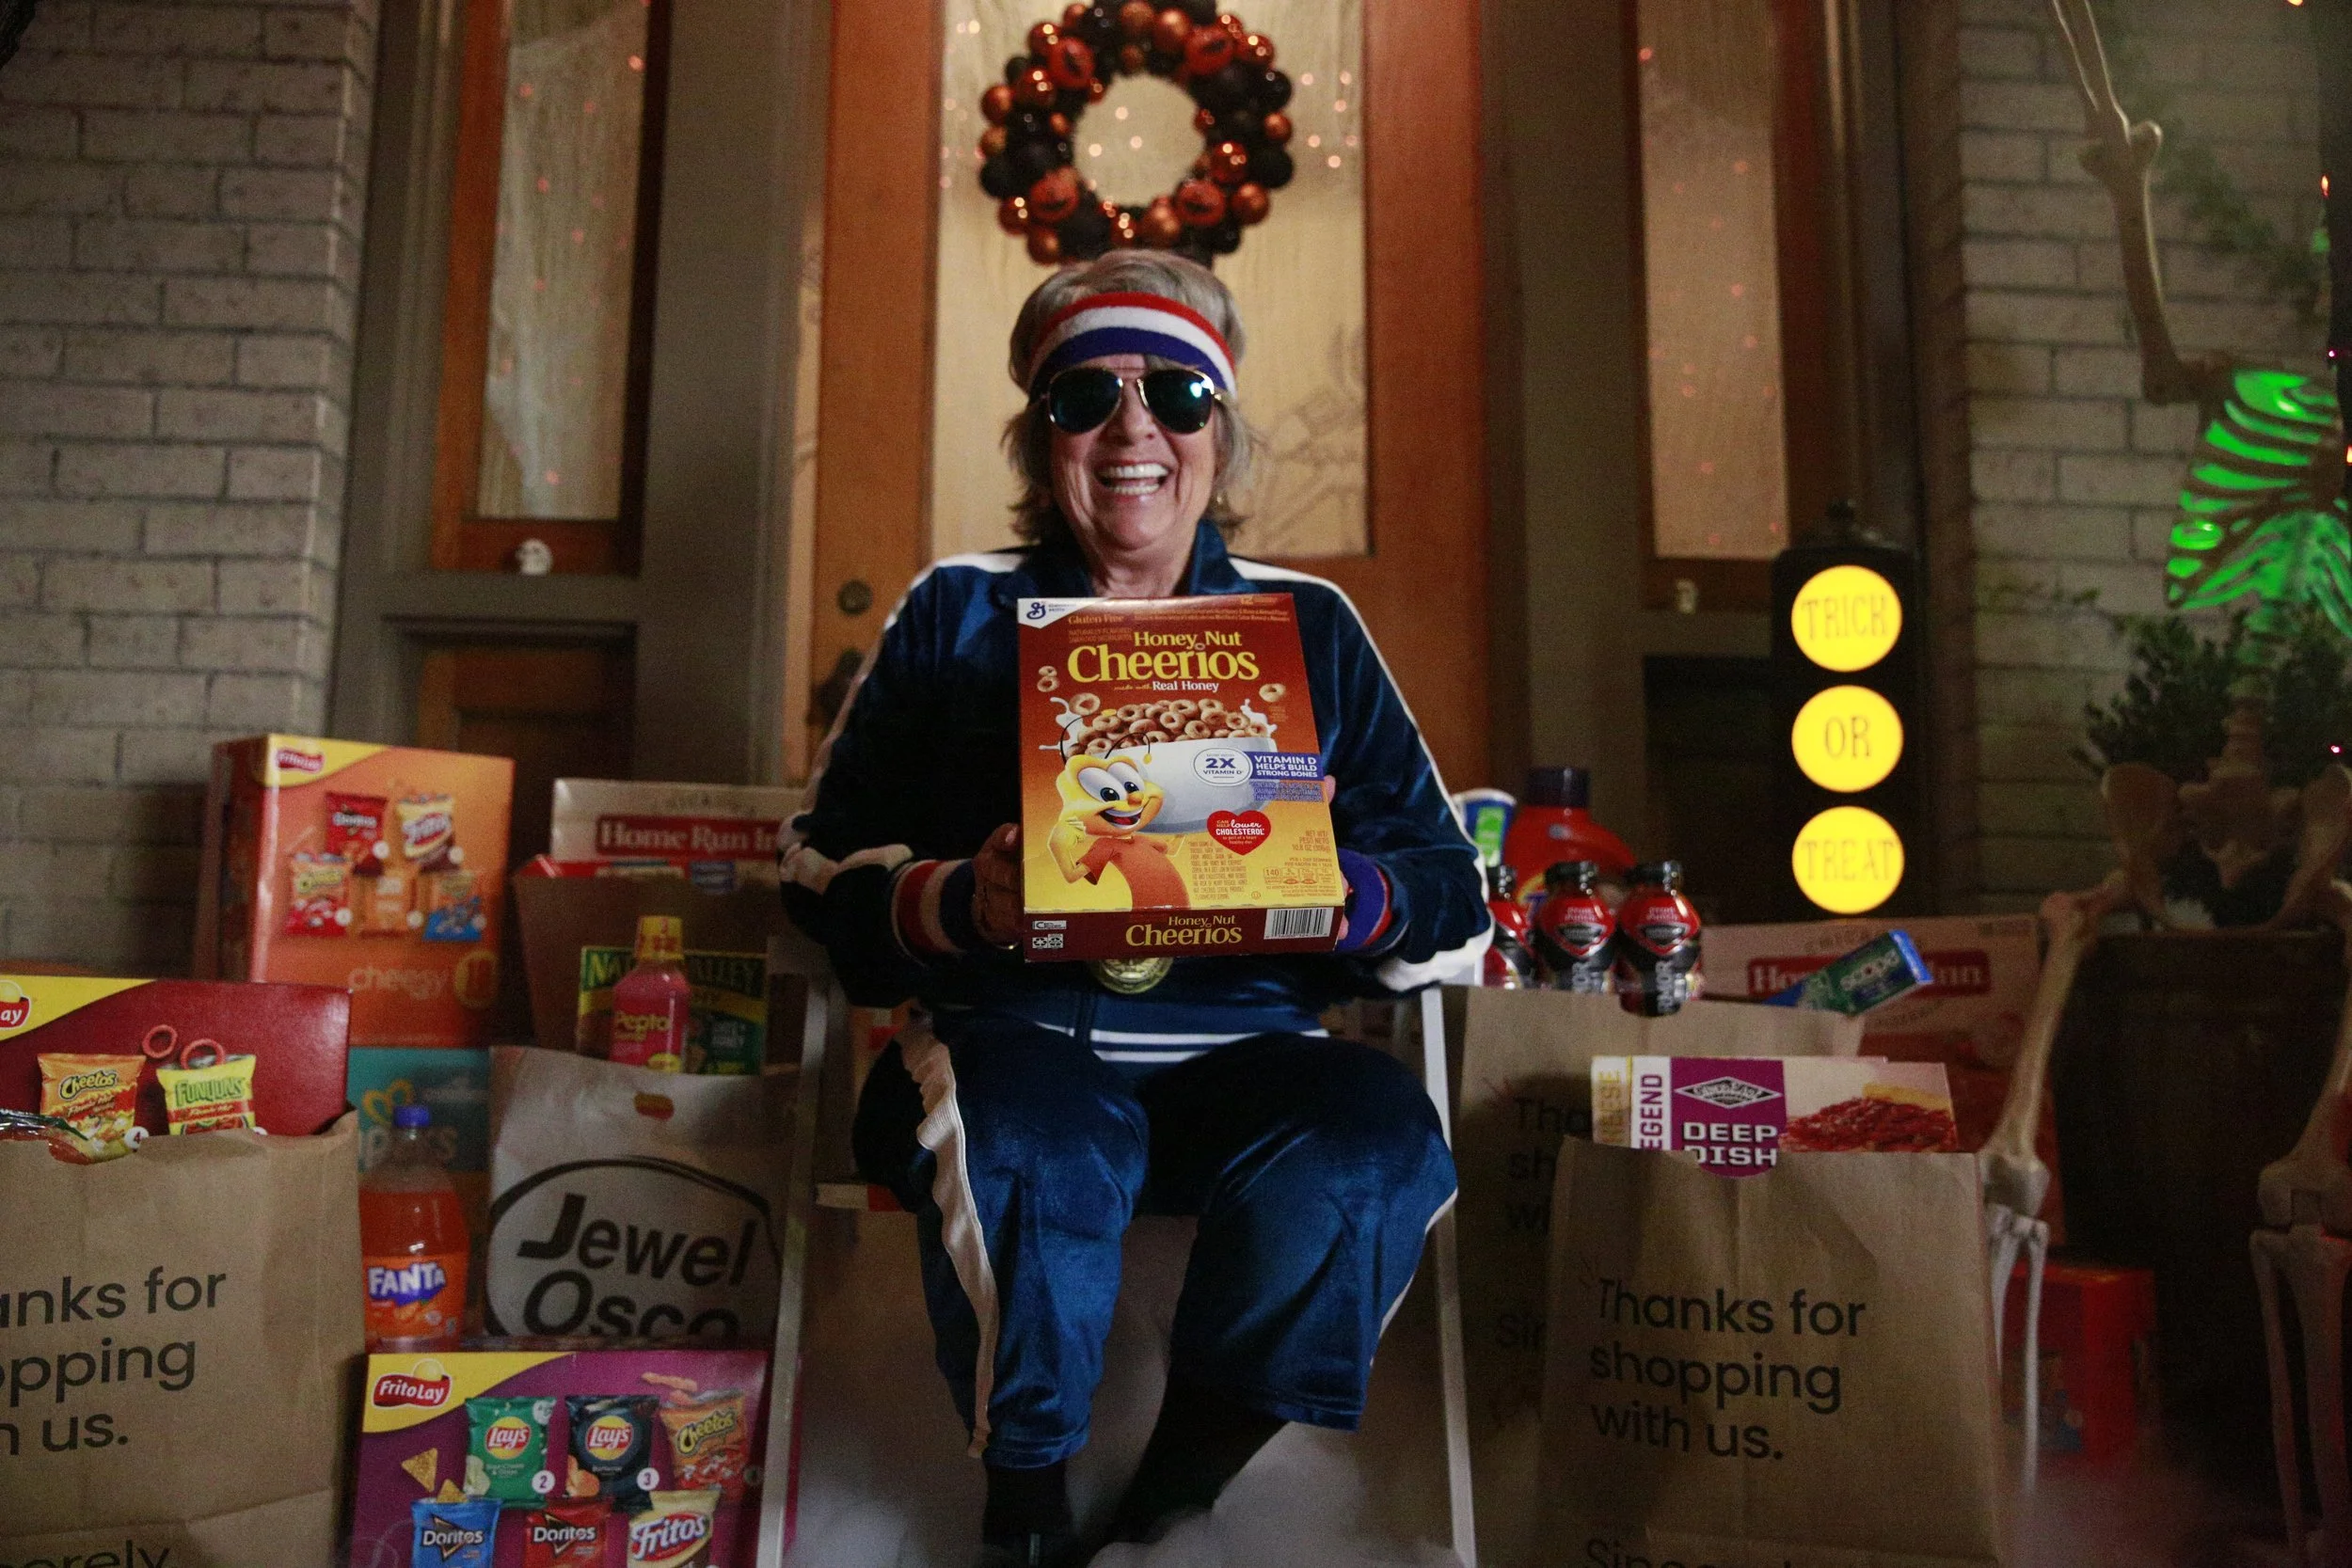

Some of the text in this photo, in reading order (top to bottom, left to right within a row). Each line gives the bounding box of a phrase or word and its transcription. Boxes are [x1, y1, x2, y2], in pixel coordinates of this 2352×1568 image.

[1801, 594, 1888, 641] TRICK
[1134, 631, 1198, 650] Honey
[1204, 631, 1242, 646] Nut
[1068, 643, 1260, 683] Cheerios
[1152, 681, 1178, 691] Real
[1182, 681, 1219, 693] Honey
[1824, 717, 1871, 759] OR
[1205, 757, 1236, 769] 2X
[1254, 755, 1317, 765] VITAMIN D
[599, 819, 688, 848] Home
[690, 823, 749, 852] Run
[1216, 828, 1264, 836] CHOLESTEROL
[1231, 819, 1263, 829] lower
[1801, 838, 1899, 882] TREAT
[1125, 924, 1243, 946] Cheerios
[1168, 914, 1236, 927] Honey Nut
[59, 1070, 118, 1100] Cheetos
[175, 1077, 245, 1106] FUNYUNS
[1640, 1074, 1662, 1150] EGEND
[1683, 1121, 1779, 1143] DEEP
[516, 1192, 758, 1288] Jewel
[368, 1261, 446, 1297] FANTA
[0, 1266, 227, 1329] nks for
[1598, 1277, 1774, 1335] Thanks
[1789, 1289, 1867, 1337] for
[0, 1337, 196, 1408] pping
[1590, 1340, 1841, 1415] shopping
[42, 1413, 129, 1452] us.
[486, 1426, 530, 1450] Lay's
[589, 1425, 630, 1450] Lay's
[679, 1411, 735, 1453] Cheetos
[1590, 1399, 1784, 1460] with us.
[539, 1475, 548, 1488] 2
[644, 1473, 651, 1486] 3
[423, 1529, 485, 1545] Doritos
[533, 1526, 596, 1543] Doritos
[631, 1515, 706, 1561] Fritos
